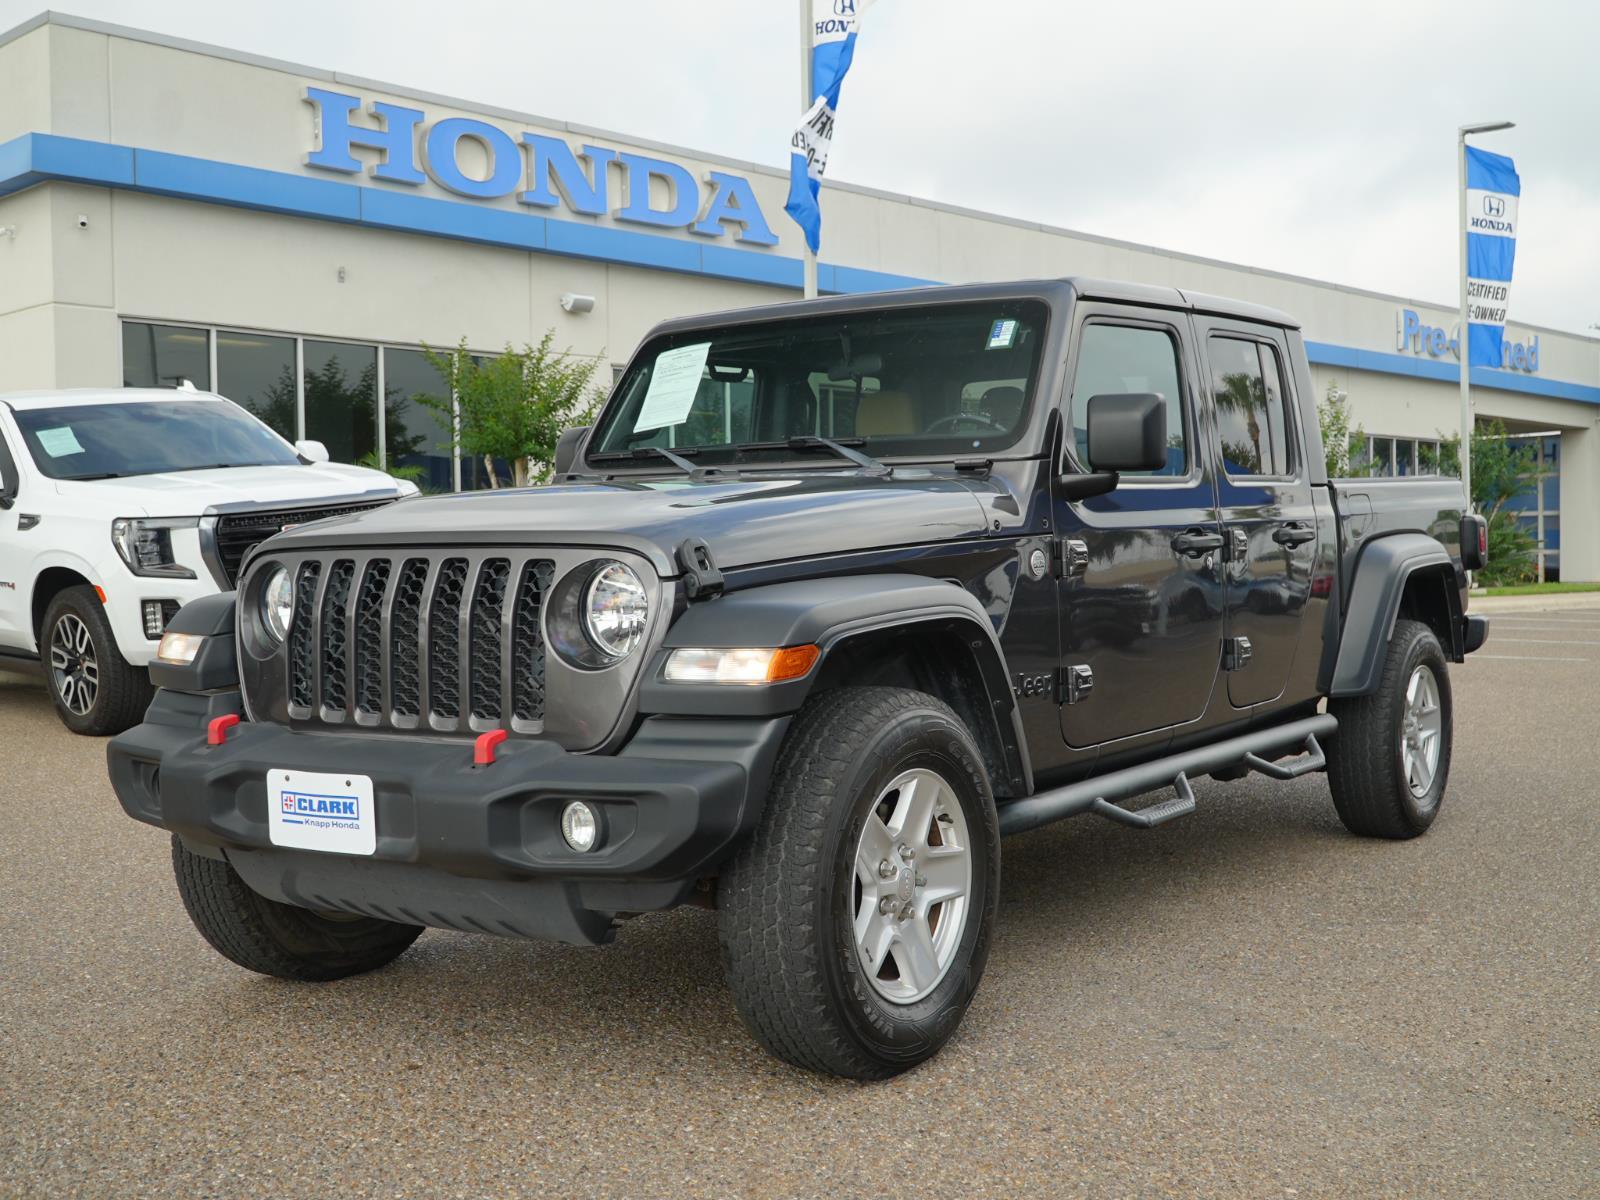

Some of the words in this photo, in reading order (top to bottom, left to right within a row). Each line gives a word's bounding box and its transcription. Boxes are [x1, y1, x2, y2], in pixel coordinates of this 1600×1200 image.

[815, 19, 855, 35] HON
[303, 86, 779, 246] HONDA
[1471, 217, 1513, 233] HONDA
[1398, 308, 1539, 373] Pre-ned
[297, 797, 355, 815] CLARK
[304, 818, 331, 829] Knapp
[332, 820, 360, 830] Honda
